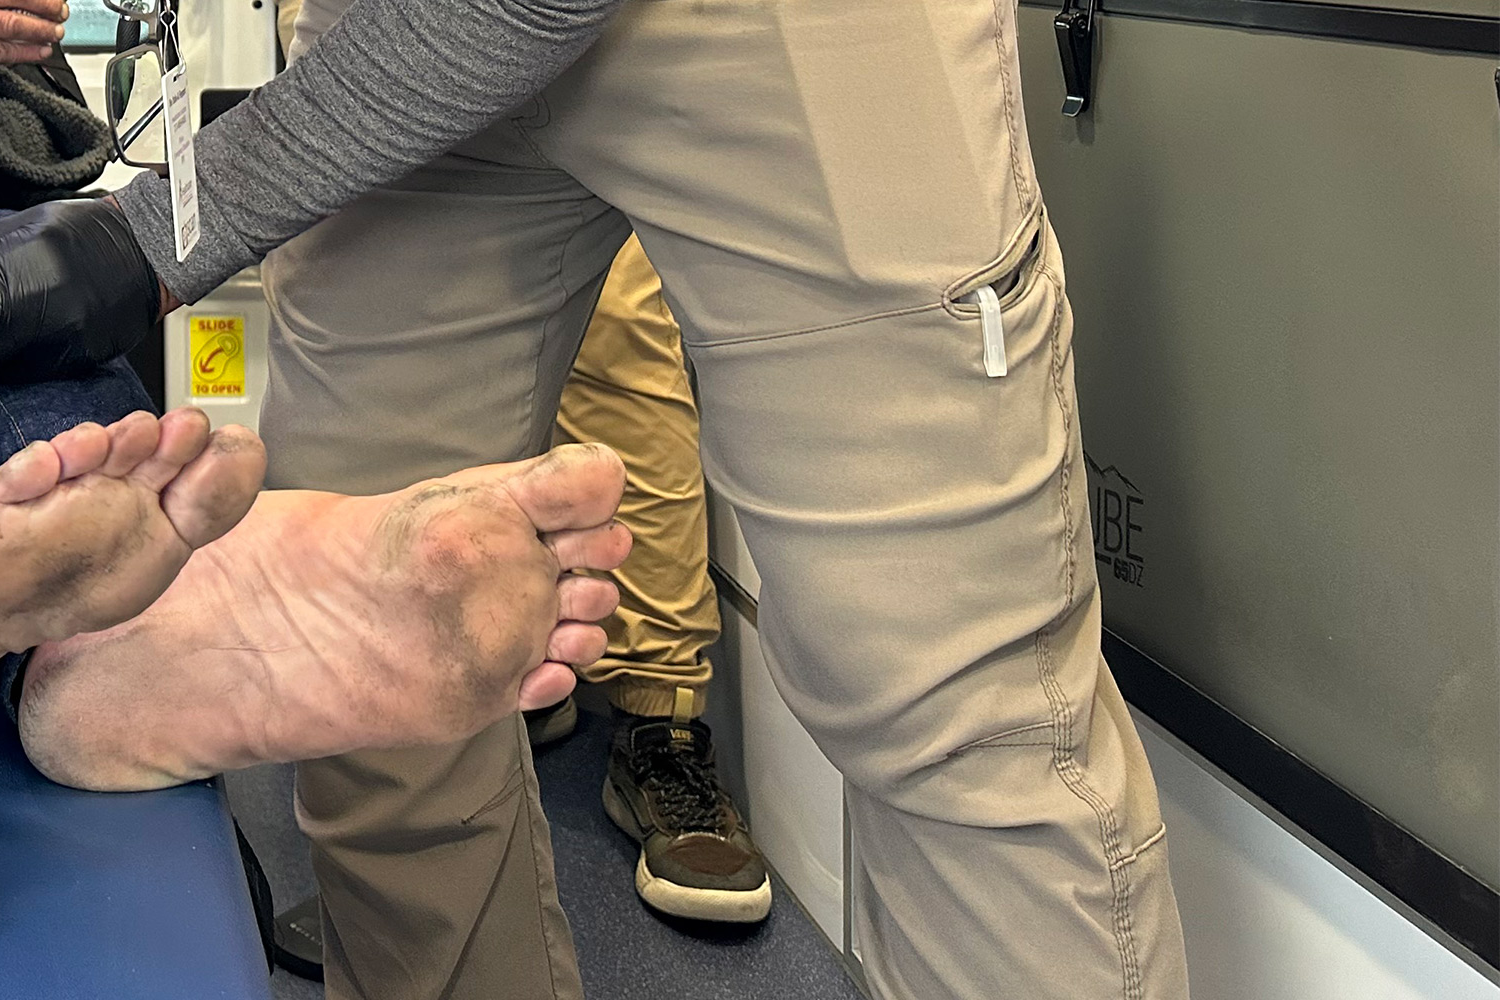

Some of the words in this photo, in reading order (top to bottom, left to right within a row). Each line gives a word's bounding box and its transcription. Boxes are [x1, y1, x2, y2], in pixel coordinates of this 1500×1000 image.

[198, 320, 236, 331] SLIDE
[196, 385, 209, 394] TO
[211, 385, 241, 394] OPEN
